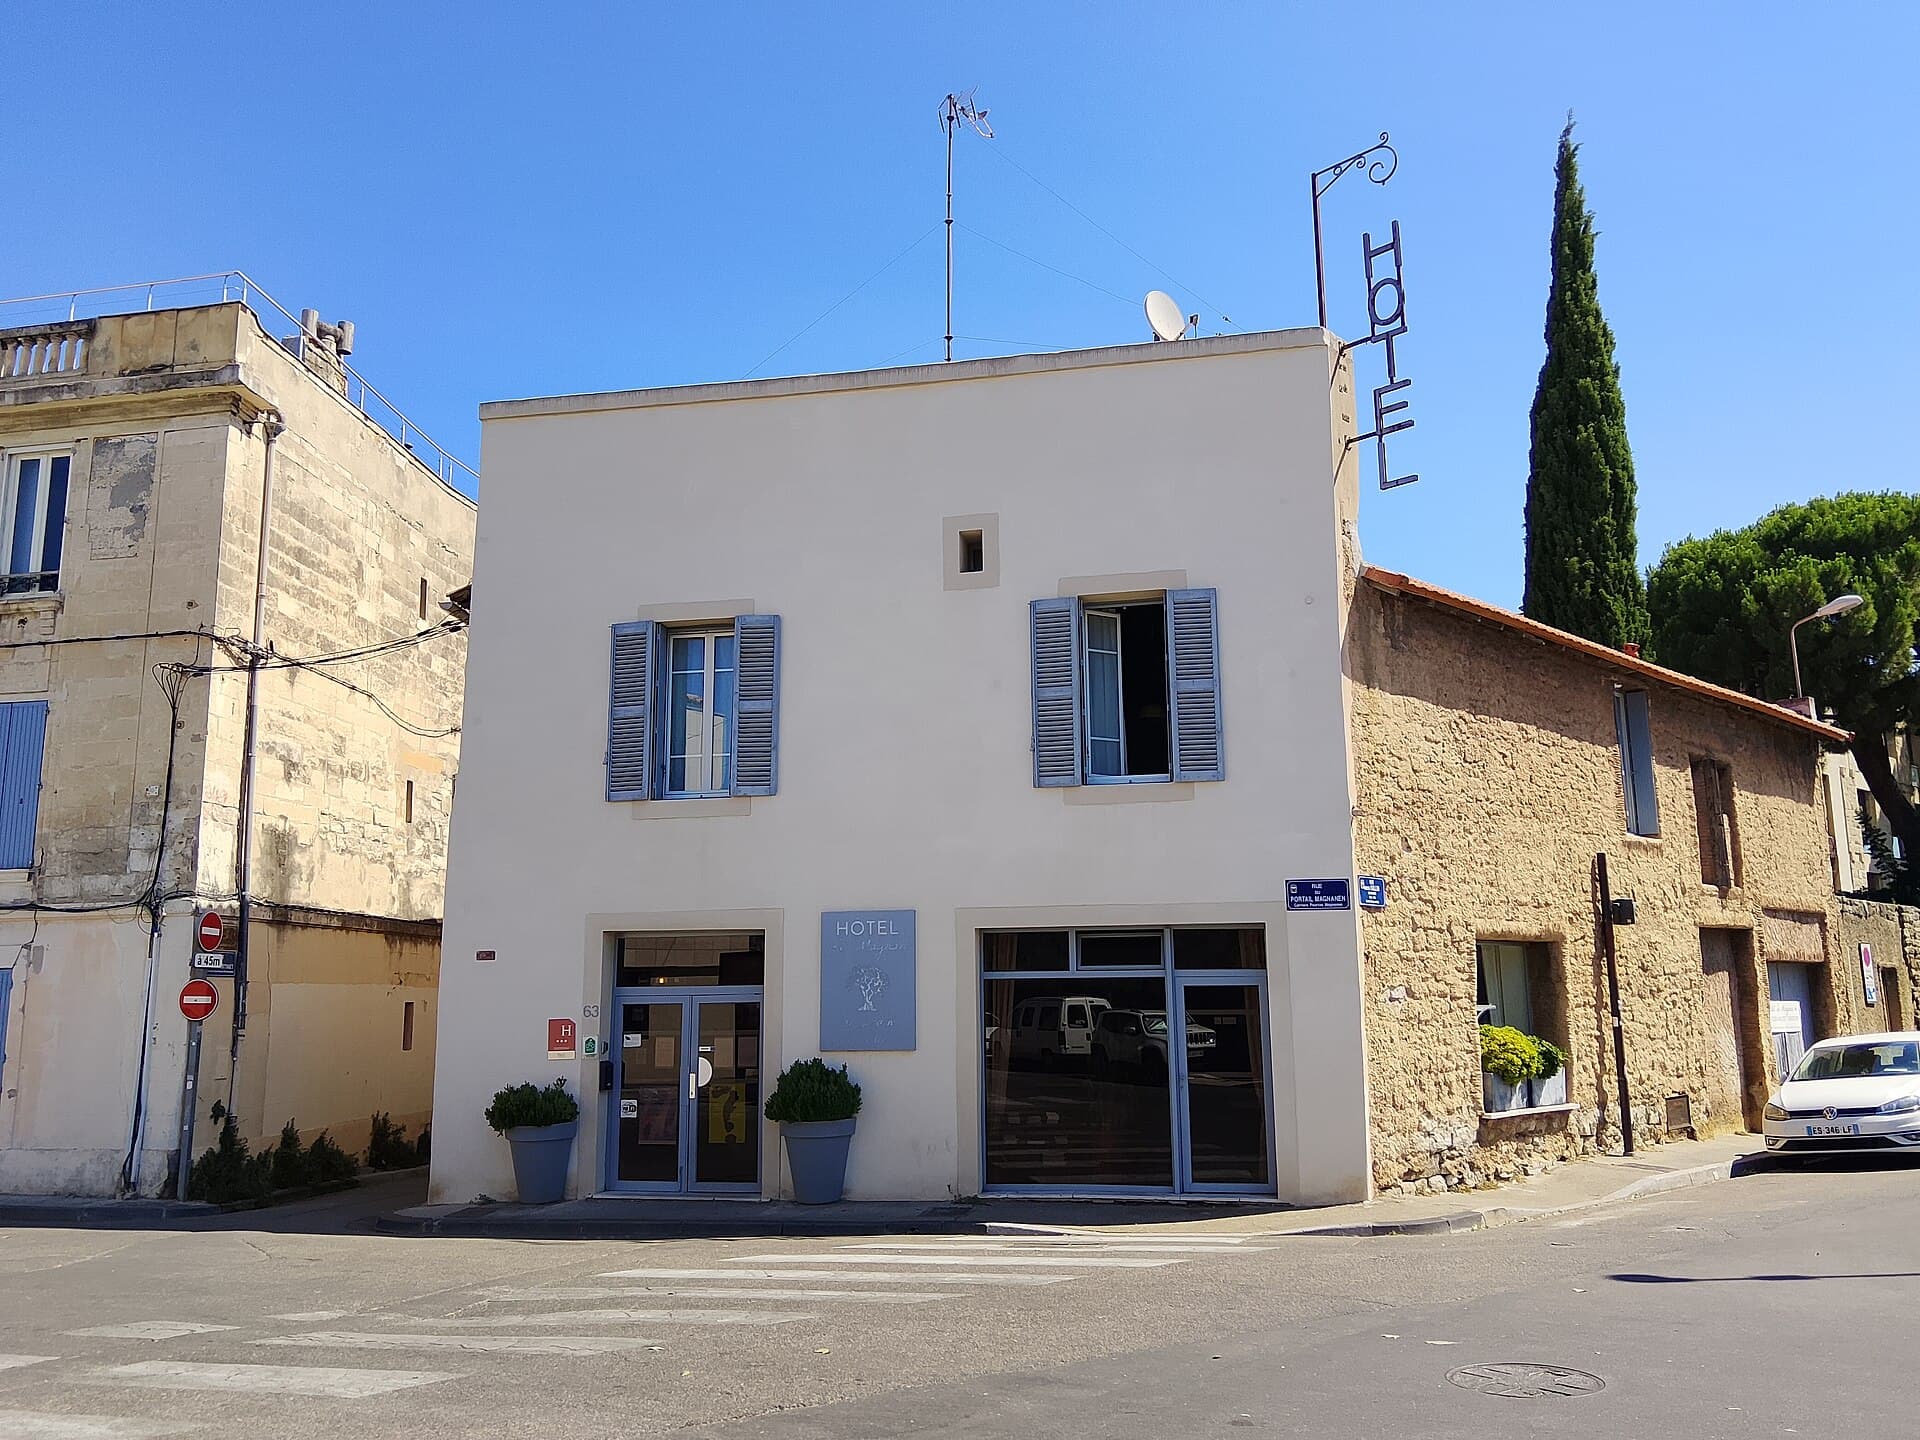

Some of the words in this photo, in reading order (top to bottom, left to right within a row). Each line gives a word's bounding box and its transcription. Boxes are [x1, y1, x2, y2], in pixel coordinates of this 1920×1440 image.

[1362, 220, 1419, 490] HOTEL
[836, 920, 899, 936] HOTEL
[583, 1005, 599, 1018] 63
[561, 1025, 572, 1037] H
